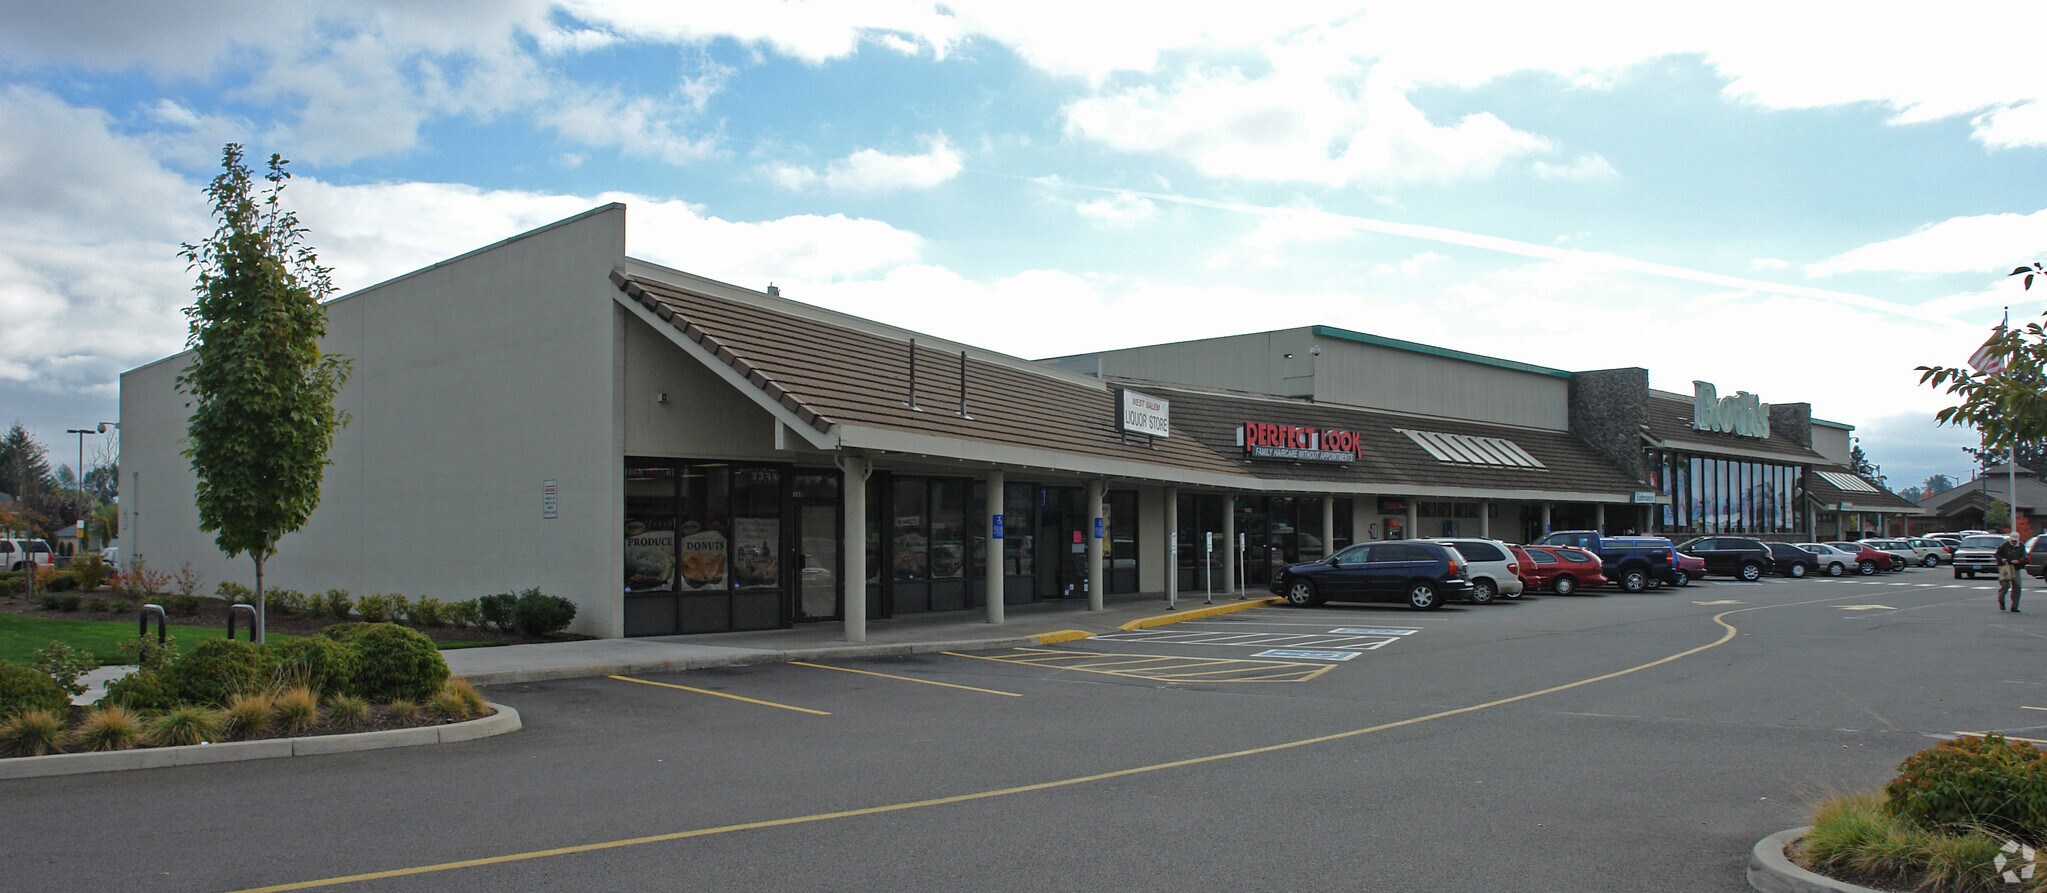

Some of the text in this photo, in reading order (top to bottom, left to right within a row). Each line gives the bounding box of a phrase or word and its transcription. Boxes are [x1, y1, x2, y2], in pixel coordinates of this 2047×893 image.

[1132, 397, 1161, 411] WEST SALEM
[1125, 409, 1167, 432] LIQUOR STORE
[1246, 423, 1362, 459] PERFECT LOOK
[1255, 447, 1354, 462] FAMILY HAIRCARE WITHOUT APPOINTMENTS
[628, 537, 673, 547] PRODUCE
[686, 541, 724, 551] DONUTS
